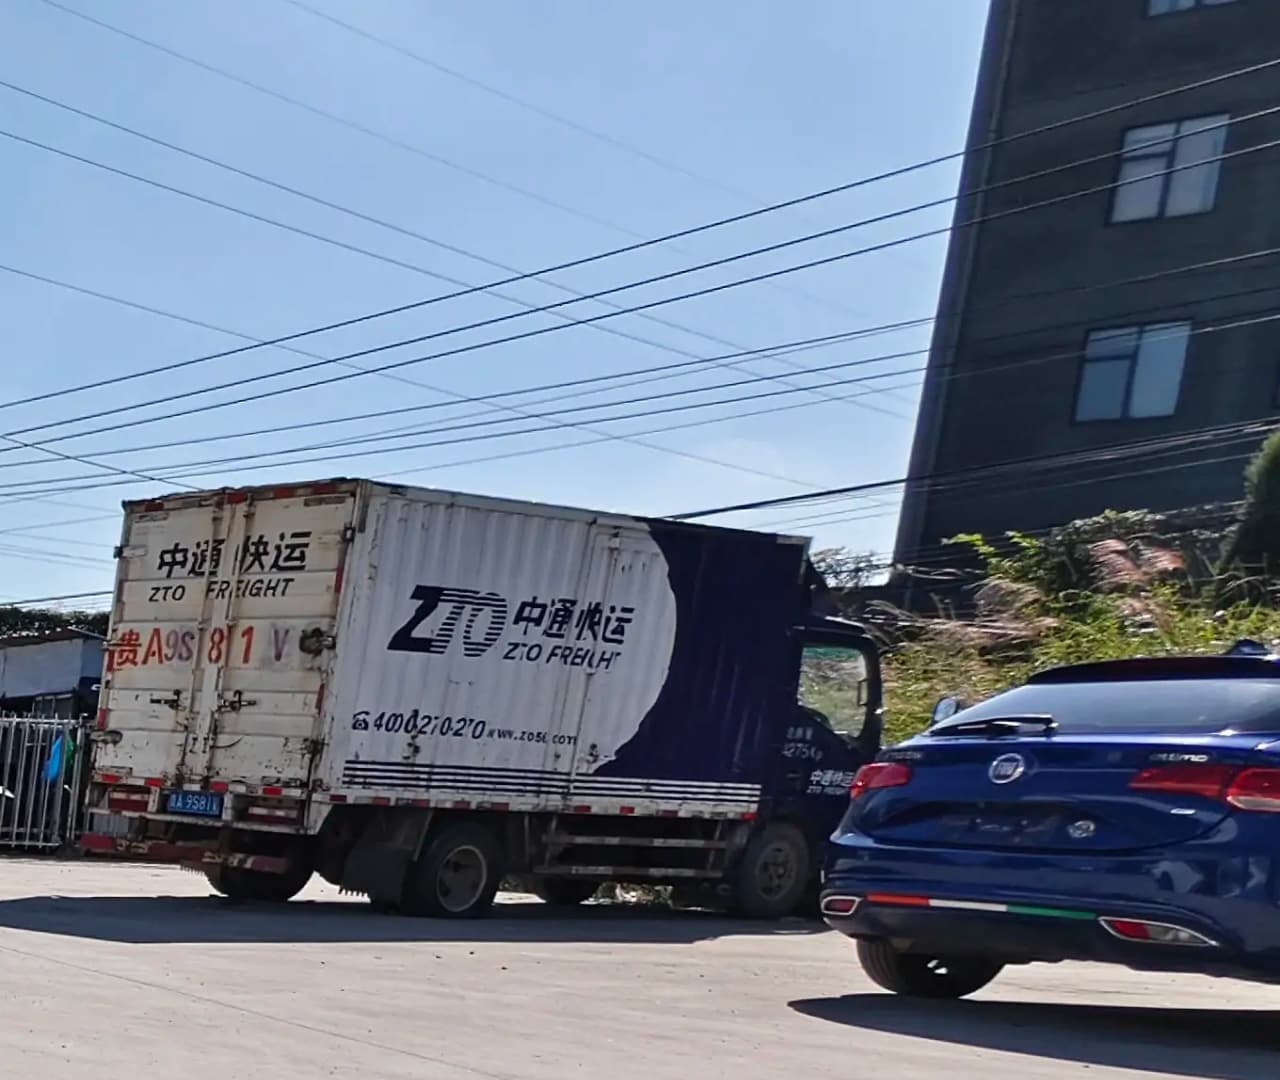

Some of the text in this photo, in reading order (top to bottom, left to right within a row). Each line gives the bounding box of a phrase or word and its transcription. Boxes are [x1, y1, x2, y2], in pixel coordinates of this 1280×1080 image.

[157, 531, 312, 579] 中通快运
[148, 578, 295, 602] ZTO FREIGHT
[512, 596, 635, 645] 中通快运
[503, 642, 542, 662] ZTO
